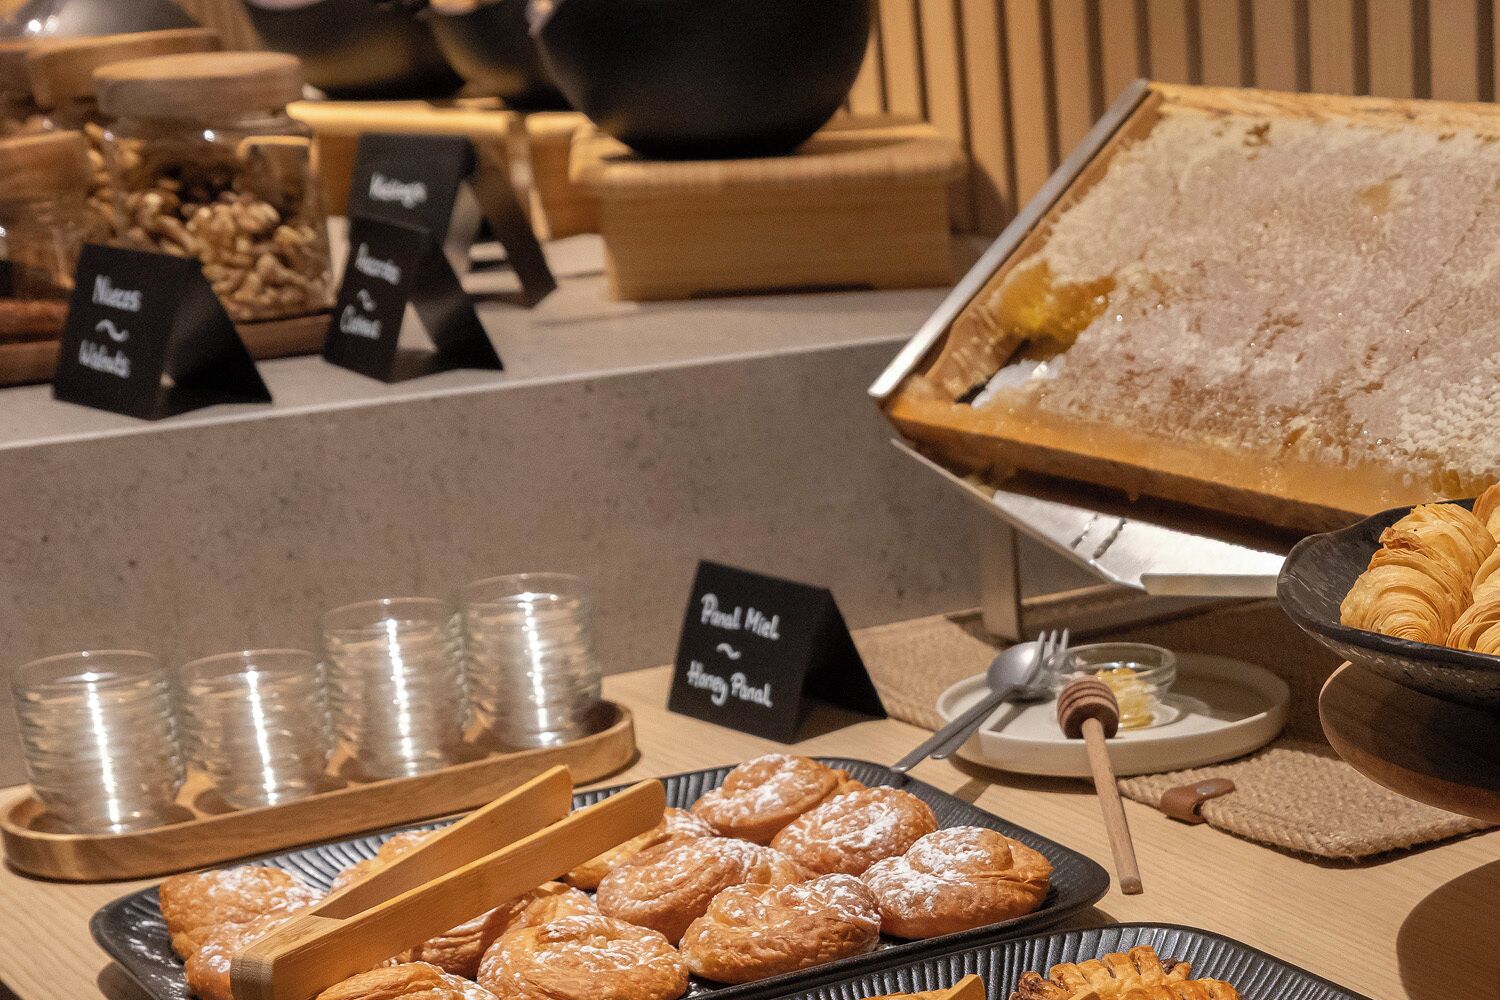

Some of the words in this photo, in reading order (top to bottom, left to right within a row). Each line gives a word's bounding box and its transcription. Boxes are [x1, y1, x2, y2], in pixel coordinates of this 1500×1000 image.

[700, 592, 741, 629] Panal
[744, 607, 780, 639] Miel
[687, 660, 728, 706] Honey
[730, 672, 773, 708] Panal
